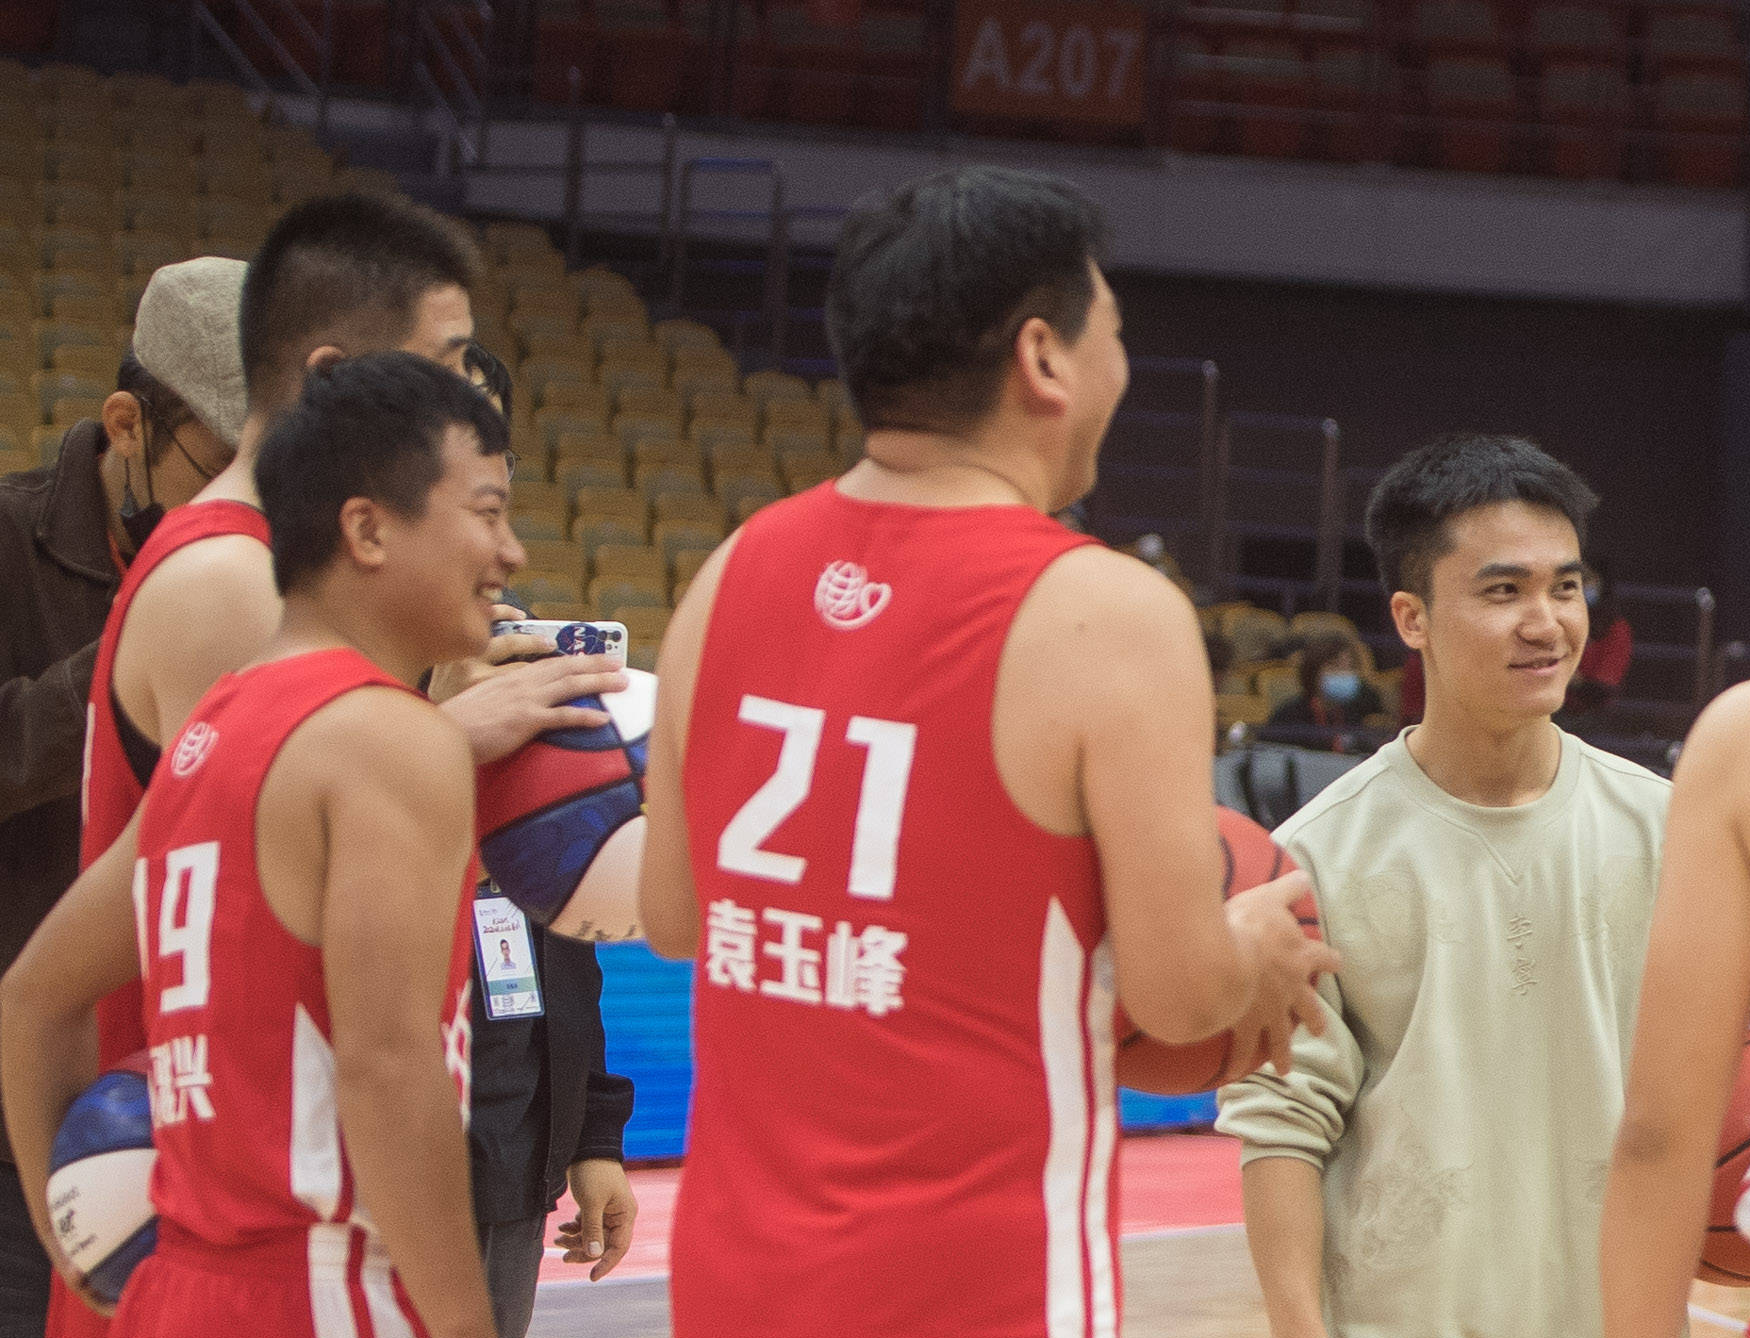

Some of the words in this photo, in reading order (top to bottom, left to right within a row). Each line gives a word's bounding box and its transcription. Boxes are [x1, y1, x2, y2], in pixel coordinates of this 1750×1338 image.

[961, 16, 1142, 100] A207
[716, 693, 919, 900] 21
[705, 898, 909, 1018] 袁玉峰
